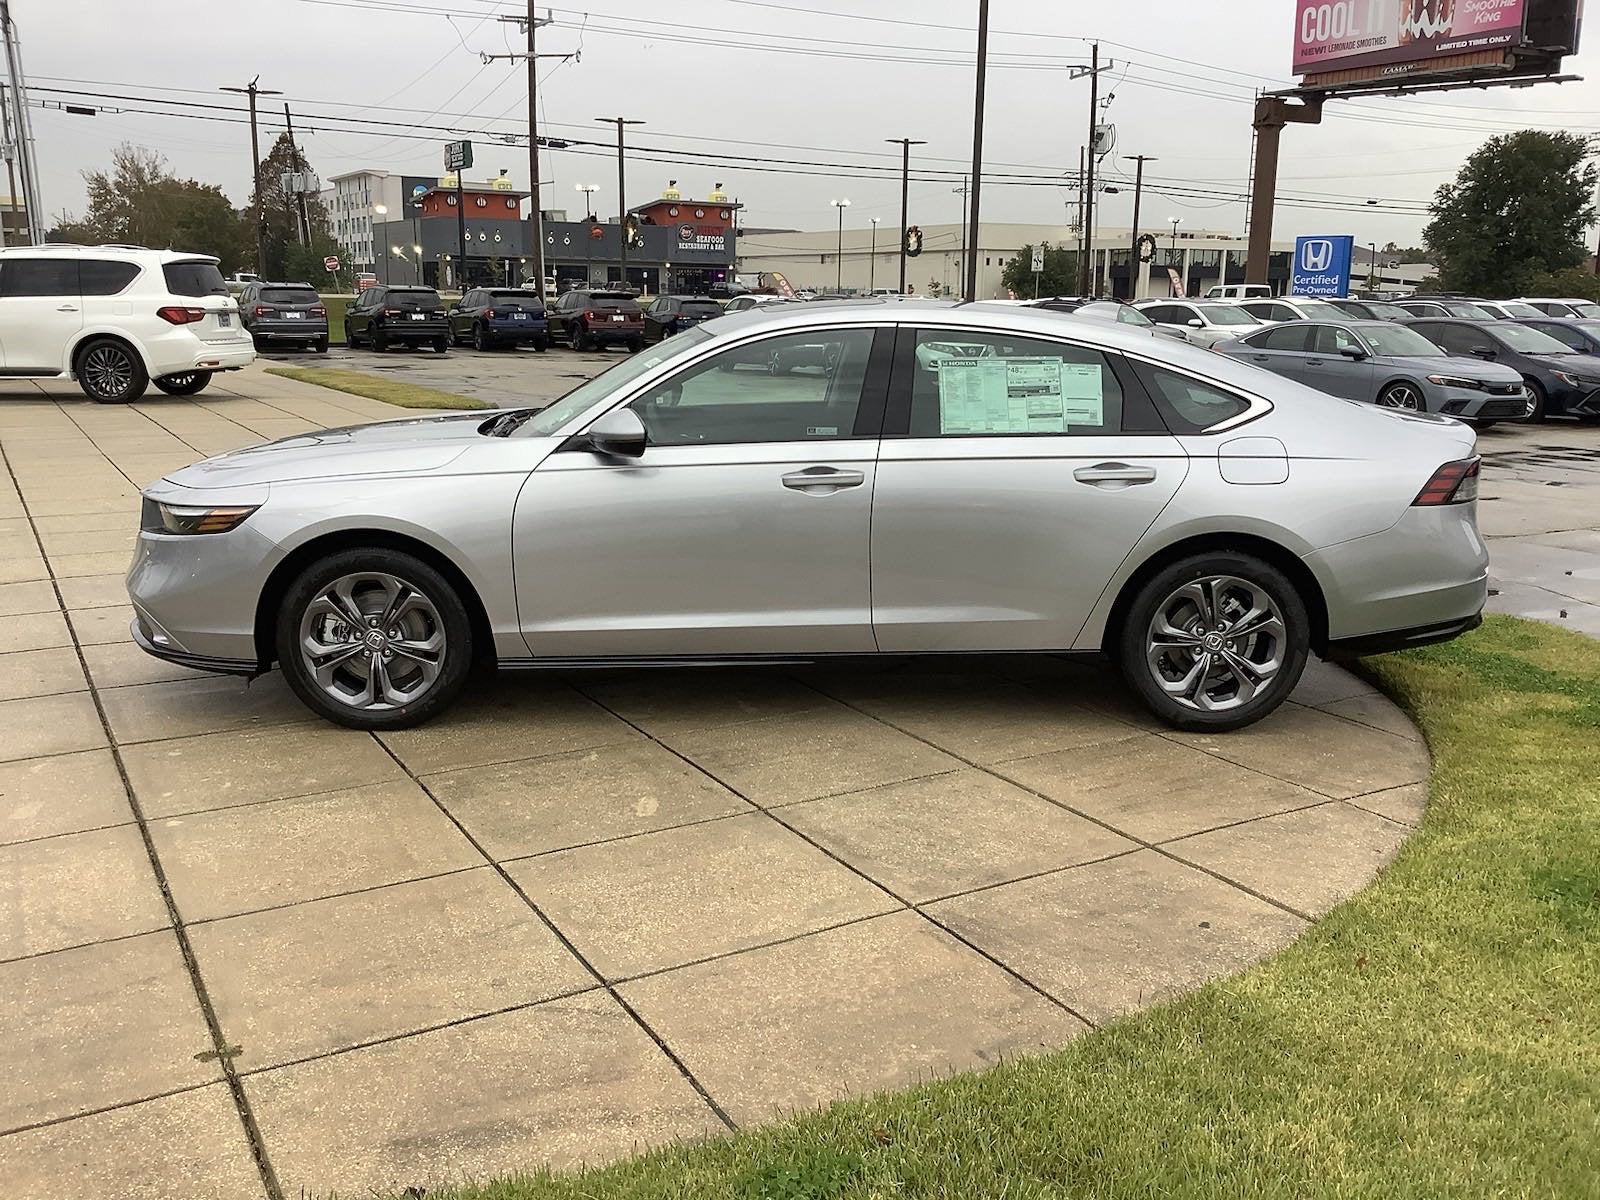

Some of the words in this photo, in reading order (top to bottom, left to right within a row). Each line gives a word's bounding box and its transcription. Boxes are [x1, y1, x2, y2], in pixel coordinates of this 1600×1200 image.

[1301, 0, 1360, 44] COOL
[1301, 46, 1326, 57] NEW!
[1328, 40, 1356, 53] LEMONADE
[1356, 36, 1387, 49] SMOOTHIES
[1436, 40, 1467, 51] LIMITED
[1468, 37, 1488, 47] TIME
[1489, 35, 1512, 44] ONLY
[696, 235, 724, 244] SEAFOOD
[1294, 275, 1339, 285] Certified
[1292, 286, 1338, 294] Pre-Owned
